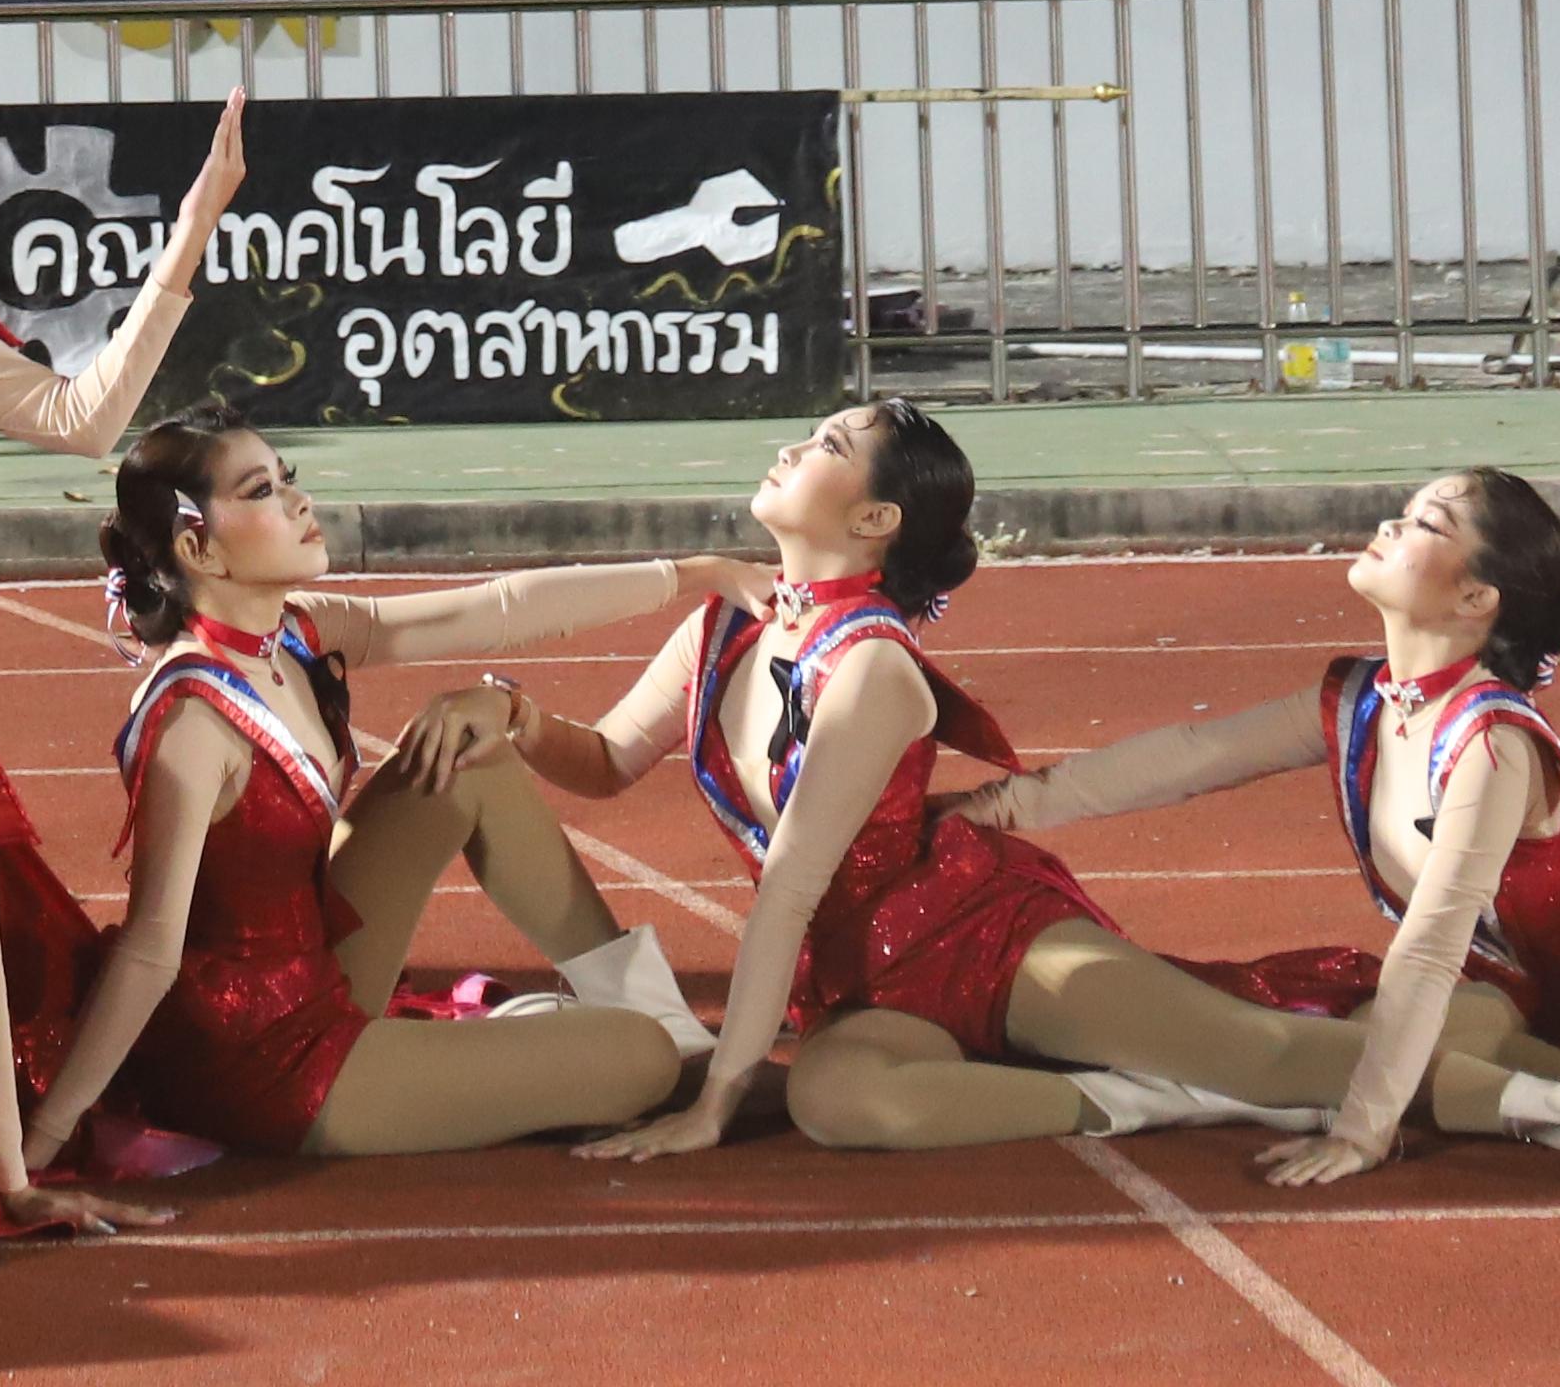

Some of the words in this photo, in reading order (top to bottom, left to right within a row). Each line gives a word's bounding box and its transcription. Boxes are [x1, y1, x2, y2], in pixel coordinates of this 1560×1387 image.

[12, 158, 574, 298] คณเทคโนโลยี
[337, 299, 780, 408] อุตสาหกรรม
